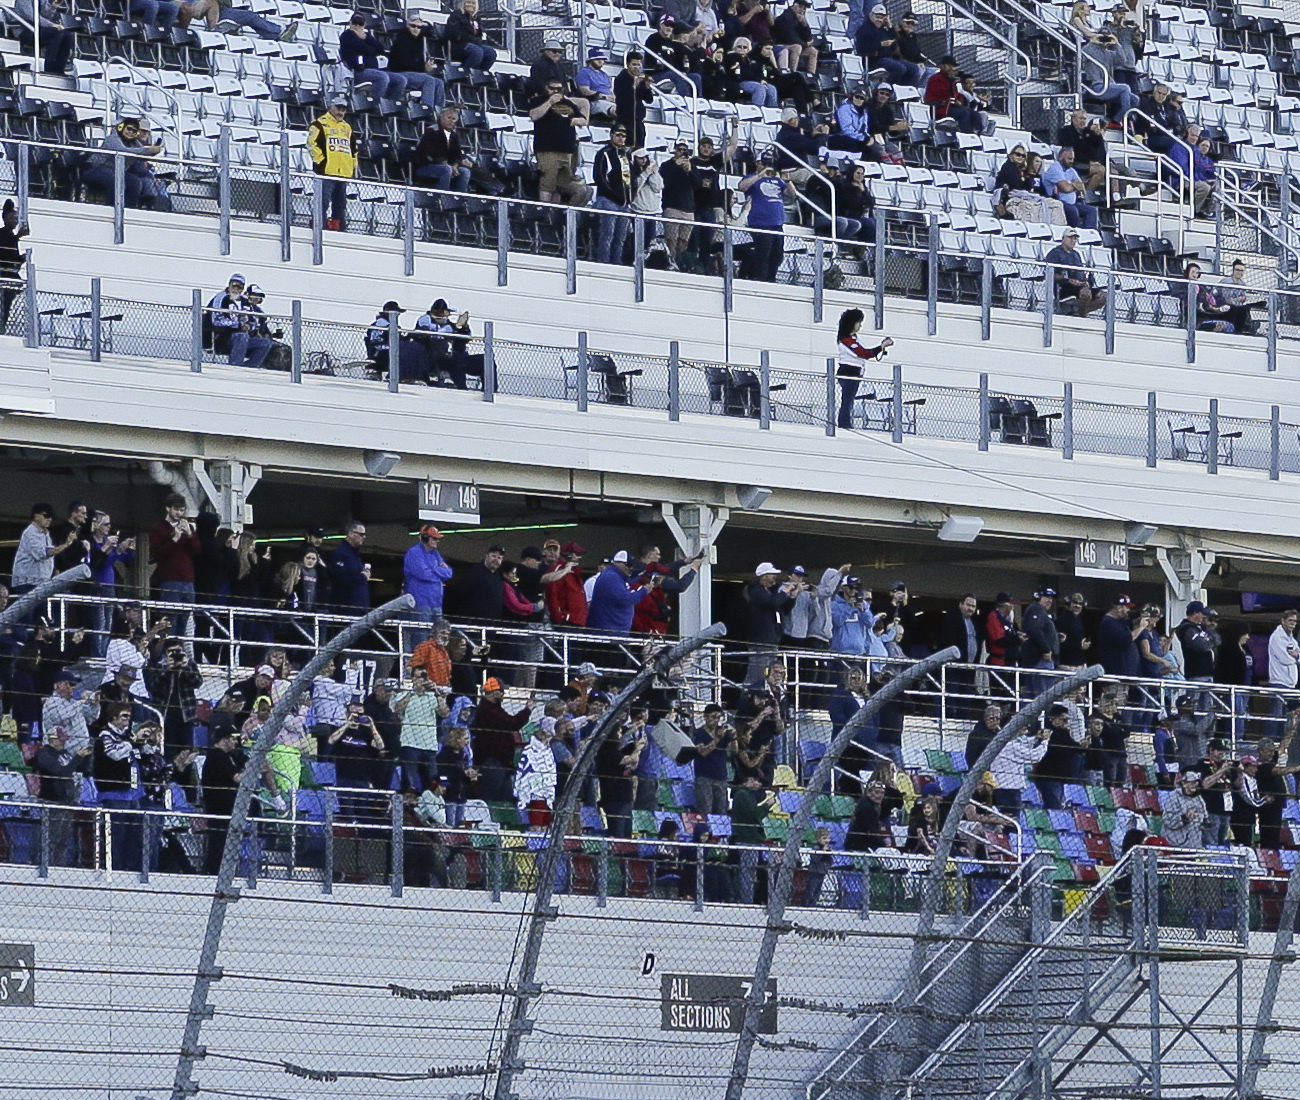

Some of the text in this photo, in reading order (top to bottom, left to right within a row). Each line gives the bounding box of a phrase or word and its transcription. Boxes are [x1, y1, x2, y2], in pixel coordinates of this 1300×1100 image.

[423, 483, 477, 509] 147 146
[1080, 541, 1126, 566] 146 145
[342, 658, 376, 704] 17
[642, 952, 655, 976] D
[670, 978, 693, 1002] ALL
[670, 1004, 731, 1030] SECTIONS
